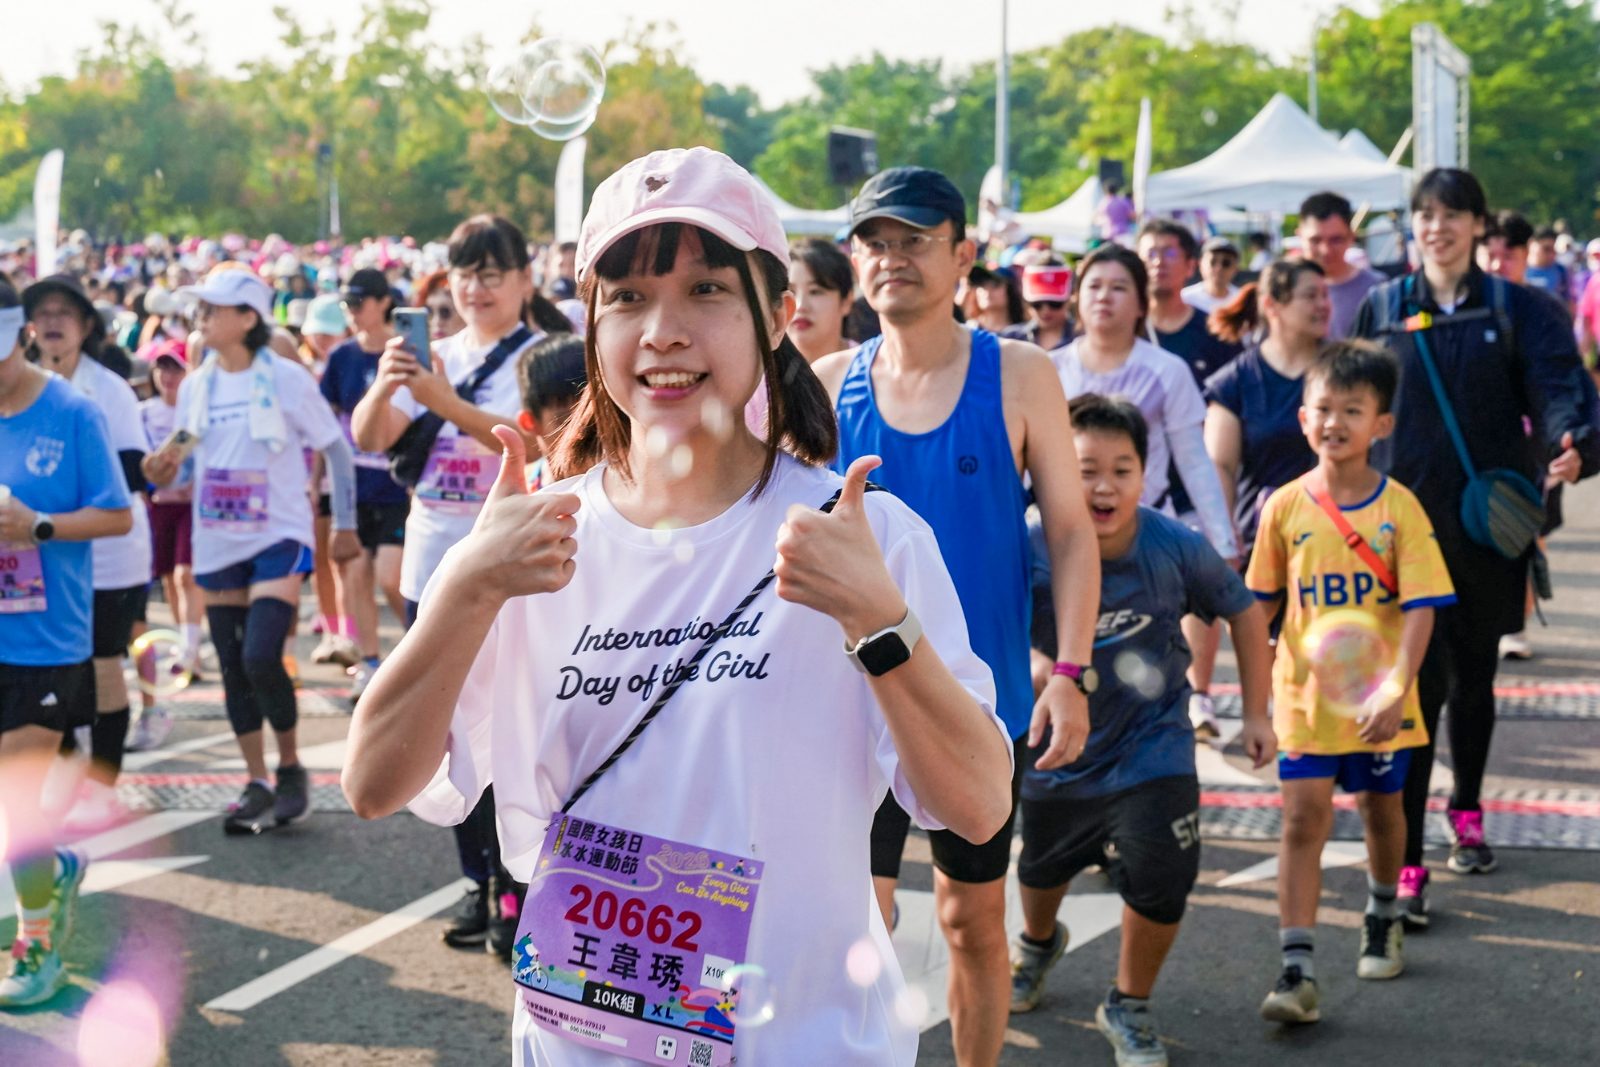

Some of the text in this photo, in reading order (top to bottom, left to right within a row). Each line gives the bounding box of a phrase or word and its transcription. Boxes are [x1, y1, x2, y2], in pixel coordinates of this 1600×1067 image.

[556, 650, 771, 706] Day of the Girl
[567, 819, 643, 854] 國際女孩日
[560, 840, 640, 875] 水水運動節
[676, 880, 750, 912] Can Be Anything
[702, 873, 750, 895] Every Girl
[564, 884, 703, 952] 20662
[568, 932, 684, 992] 王韋琇
[593, 988, 636, 1013] 10K組
